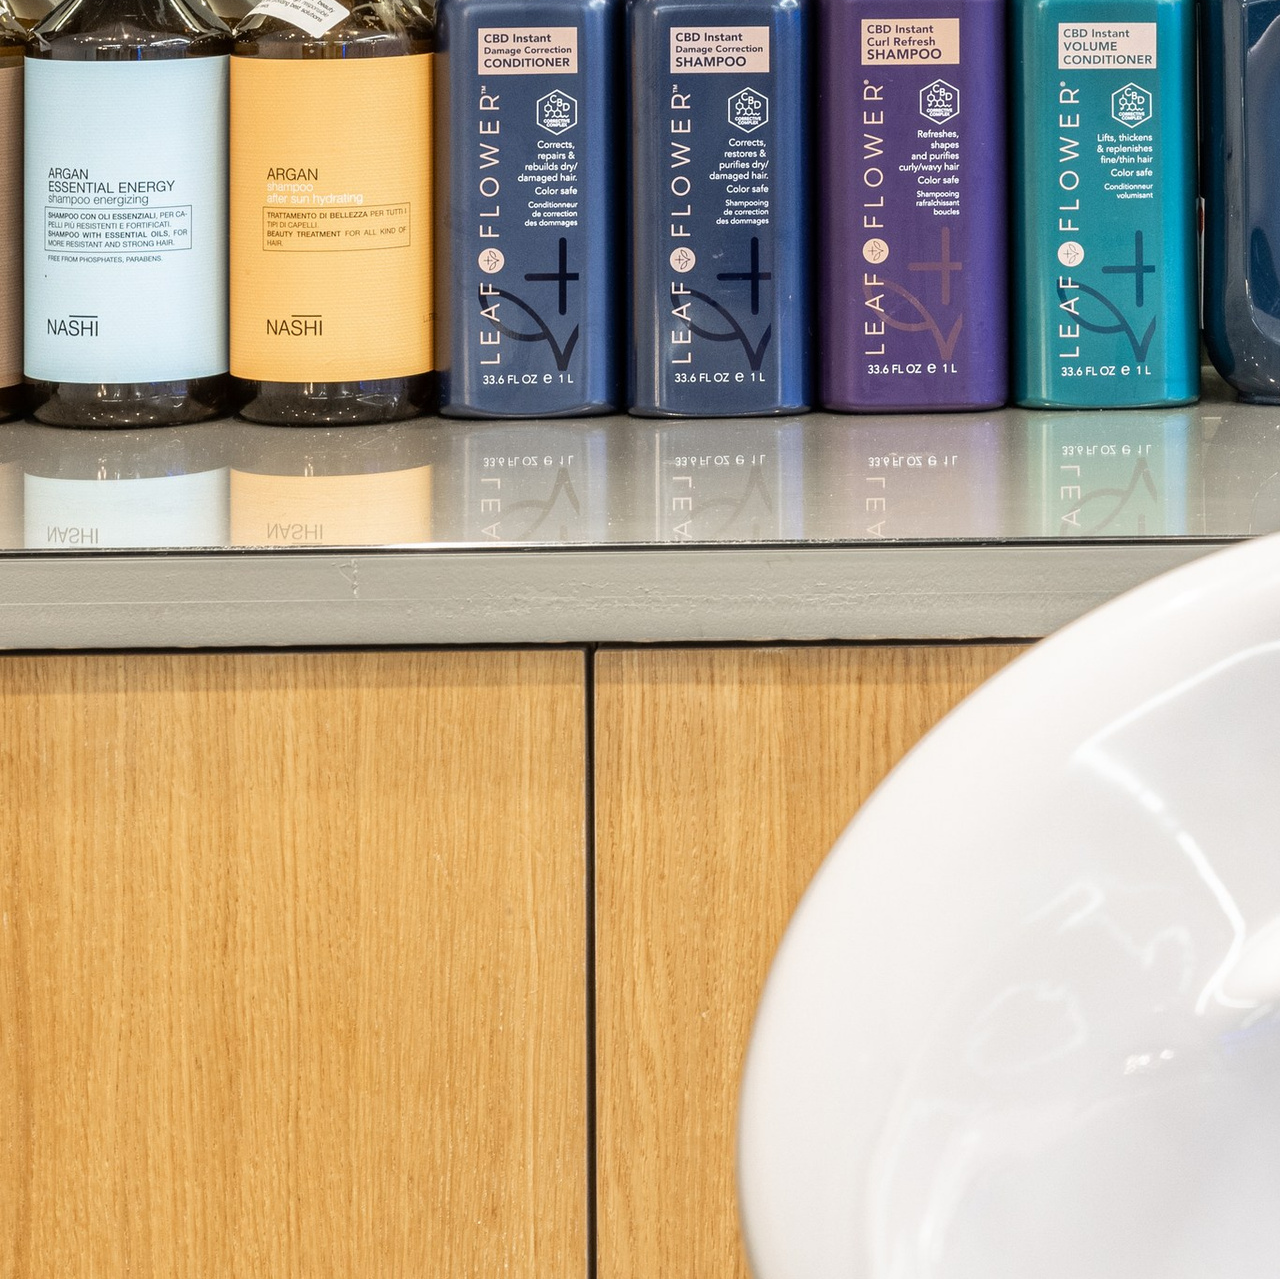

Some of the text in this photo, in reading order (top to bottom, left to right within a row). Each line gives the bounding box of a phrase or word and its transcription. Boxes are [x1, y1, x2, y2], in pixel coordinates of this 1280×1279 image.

[483, 33, 552, 43] CBD Instant
[866, 36, 936, 47] Curl Refresh
[483, 45, 572, 56] Damage Correction
[1063, 42, 1117, 52] VOLUME
[866, 48, 942, 61] SHAMPOO
[1062, 54, 1152, 66] CONDITIONER
[483, 57, 570, 68] CONDITIONER
[917, 130, 959, 139] Refreshes,
[1096, 133, 1153, 143] Lifts, thickens
[48, 168, 88, 179] ARGAN
[48, 180, 175, 193] ESSENTIAL ENERGY
[267, 182, 314, 193] shampoo
[725, 184, 769, 194] Color safe
[1104, 183, 1154, 191] Conditionneur
[48, 194, 149, 206] shampoo energizing
[267, 193, 363, 205] after sun hydrating
[864, 271, 884, 356] LEAF
[47, 319, 98, 336] NASHI
[267, 319, 322, 336] NASHI
[479, 281, 501, 365] LEAF
[482, 373, 538, 385] 33.6 FL OZ
